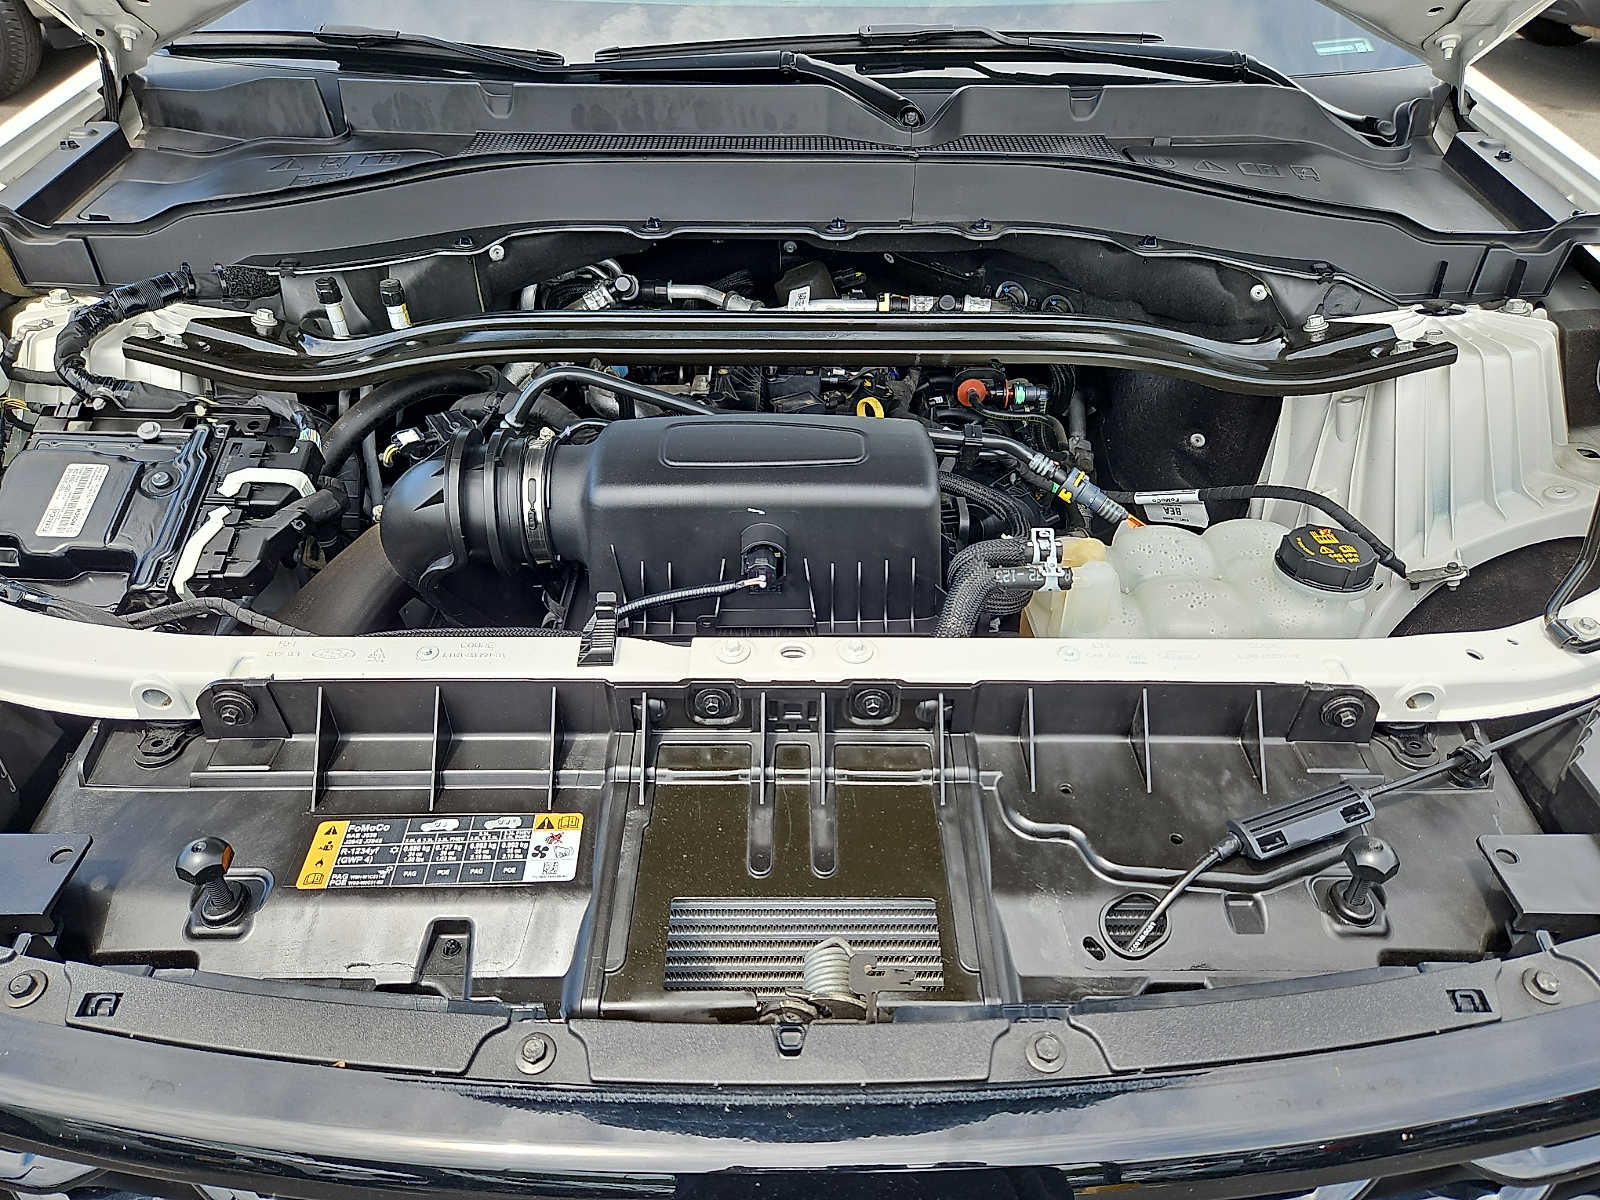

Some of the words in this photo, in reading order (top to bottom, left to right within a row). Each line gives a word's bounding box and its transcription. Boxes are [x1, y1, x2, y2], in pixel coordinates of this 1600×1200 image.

[1162, 507, 1182, 516] BEA
[348, 823, 391, 832] FoMoCo
[340, 846, 380, 855] R-1234yf
[337, 856, 363, 864] (GWP
[469, 867, 484, 875] PAG
